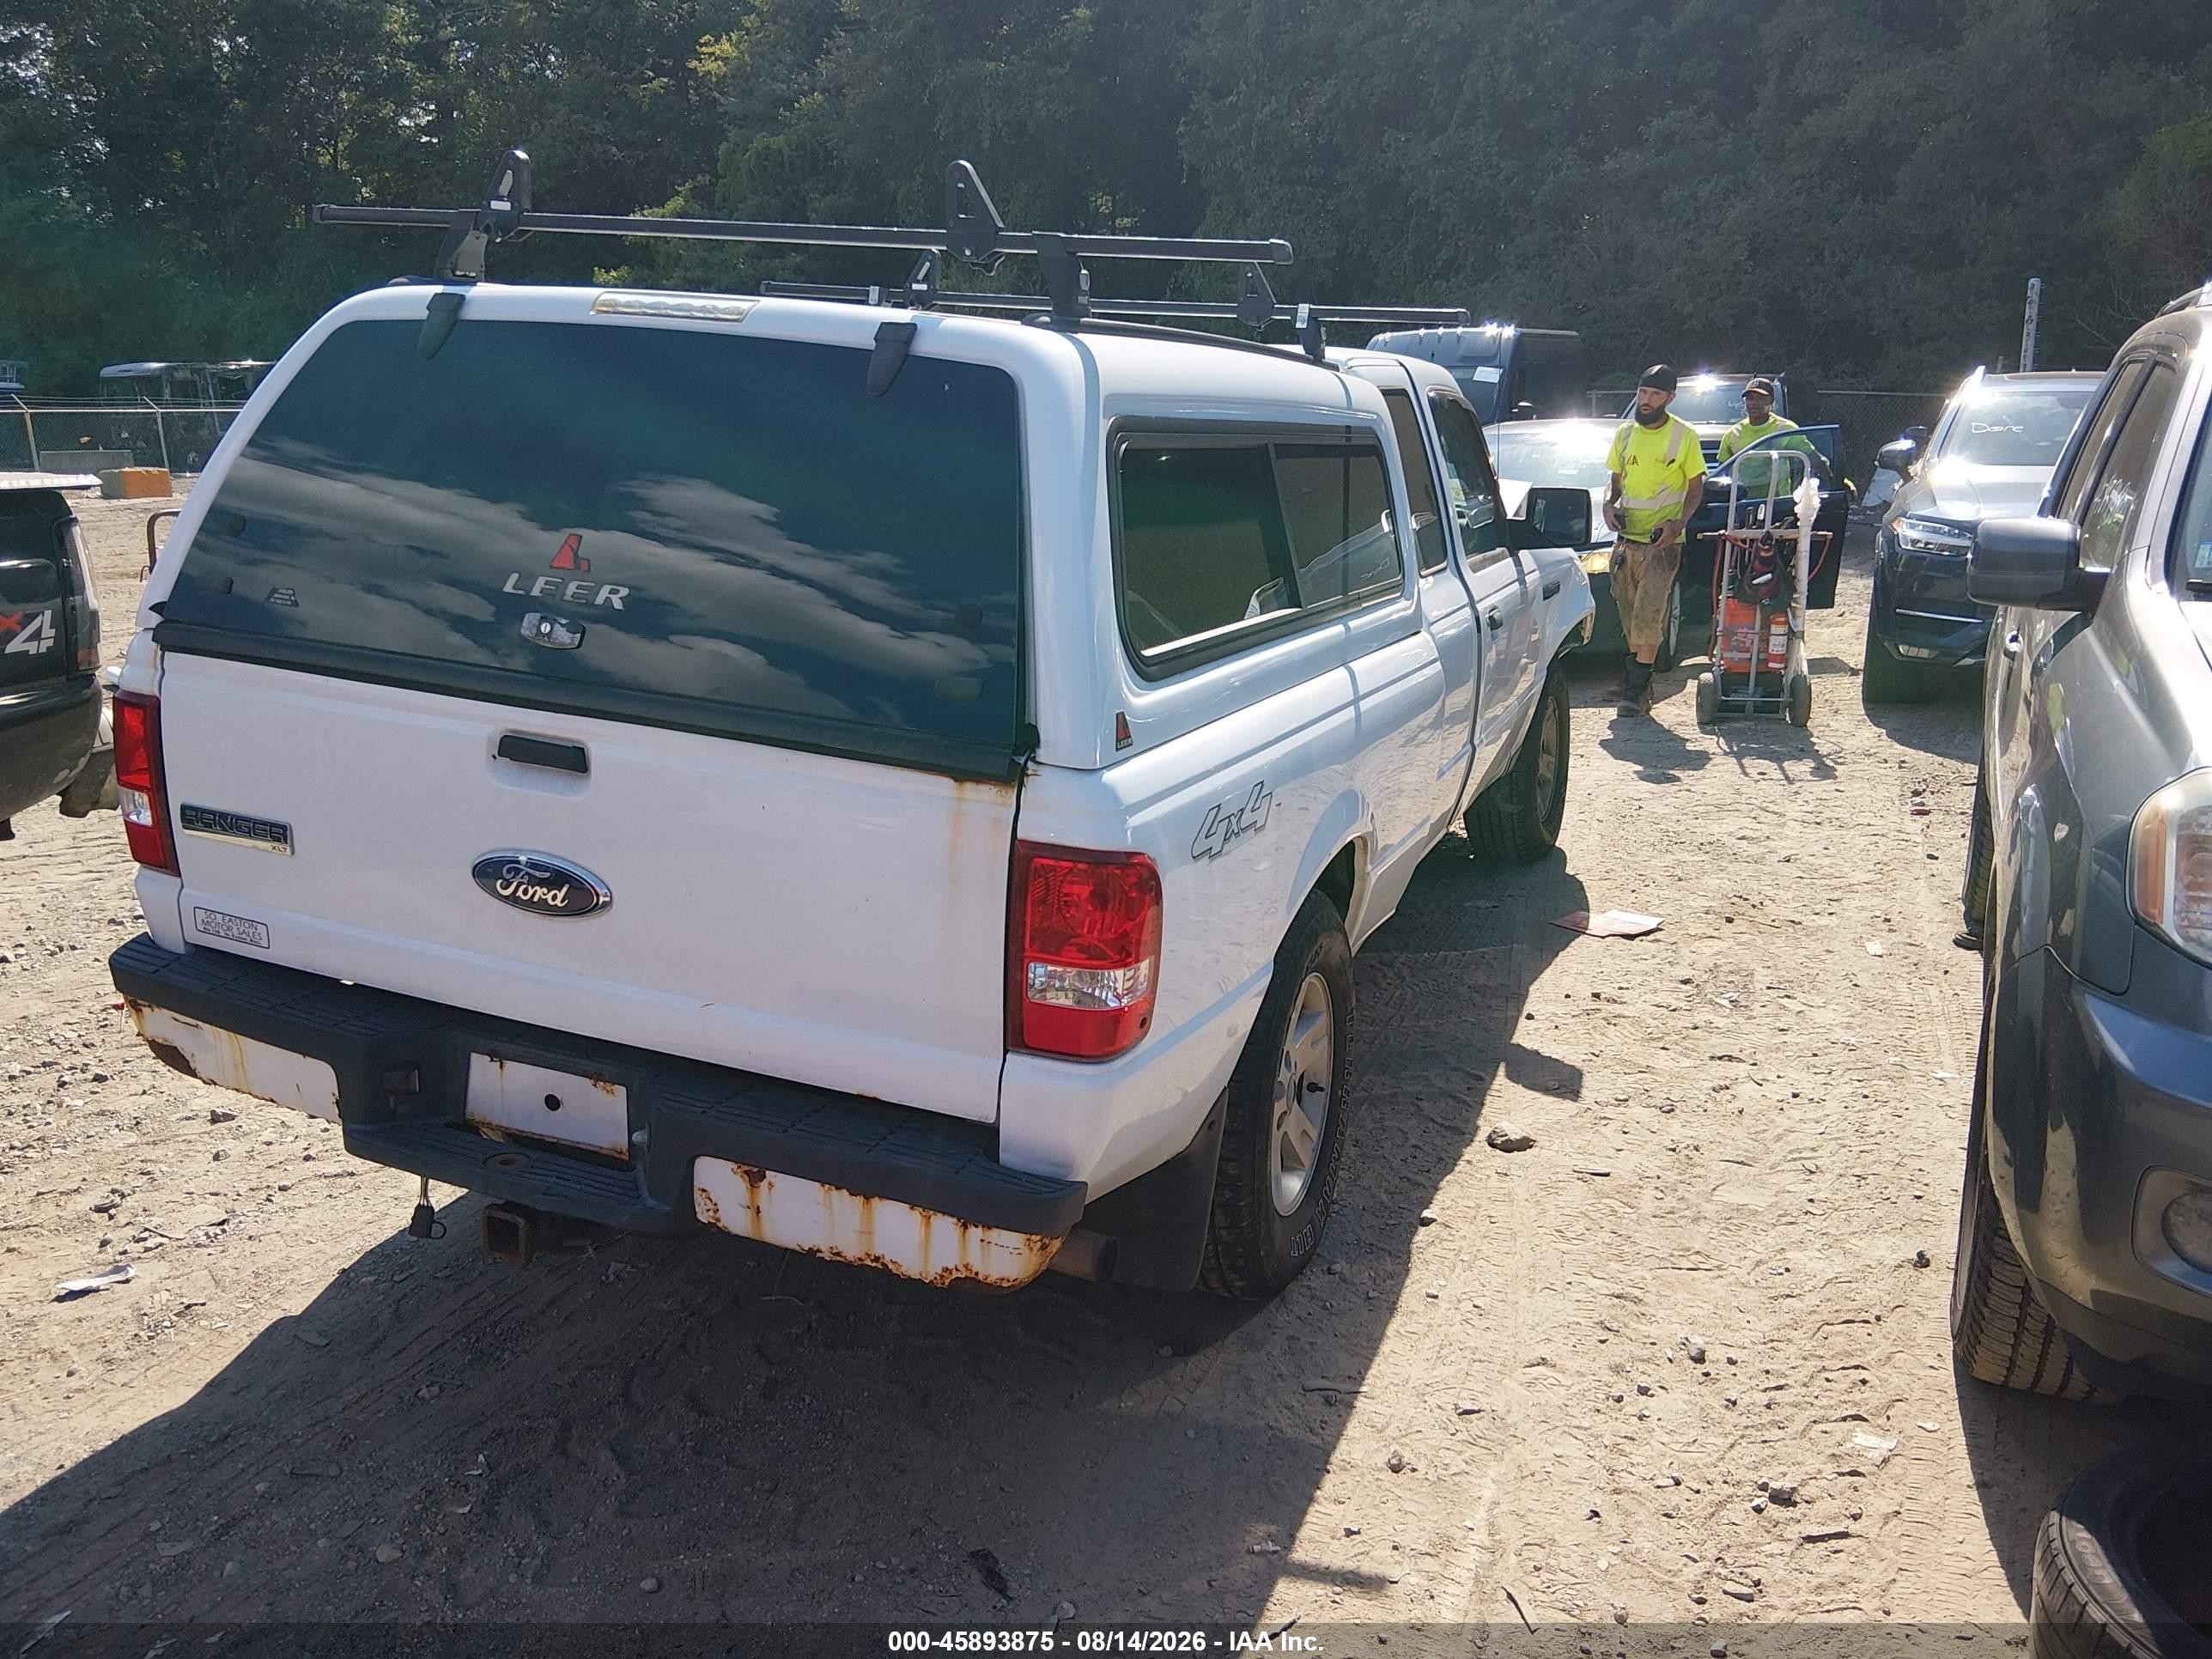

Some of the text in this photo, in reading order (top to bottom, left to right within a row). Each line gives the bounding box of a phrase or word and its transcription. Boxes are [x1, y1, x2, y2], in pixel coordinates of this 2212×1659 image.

[502, 572, 630, 611] LEER
[182, 810, 289, 843] RANGER
[270, 844, 288, 854] XLT
[495, 863, 570, 908] Ford
[201, 918, 234, 935] MOTOR
[236, 927, 263, 941] SALES
[222, 915, 258, 931] EASTON
